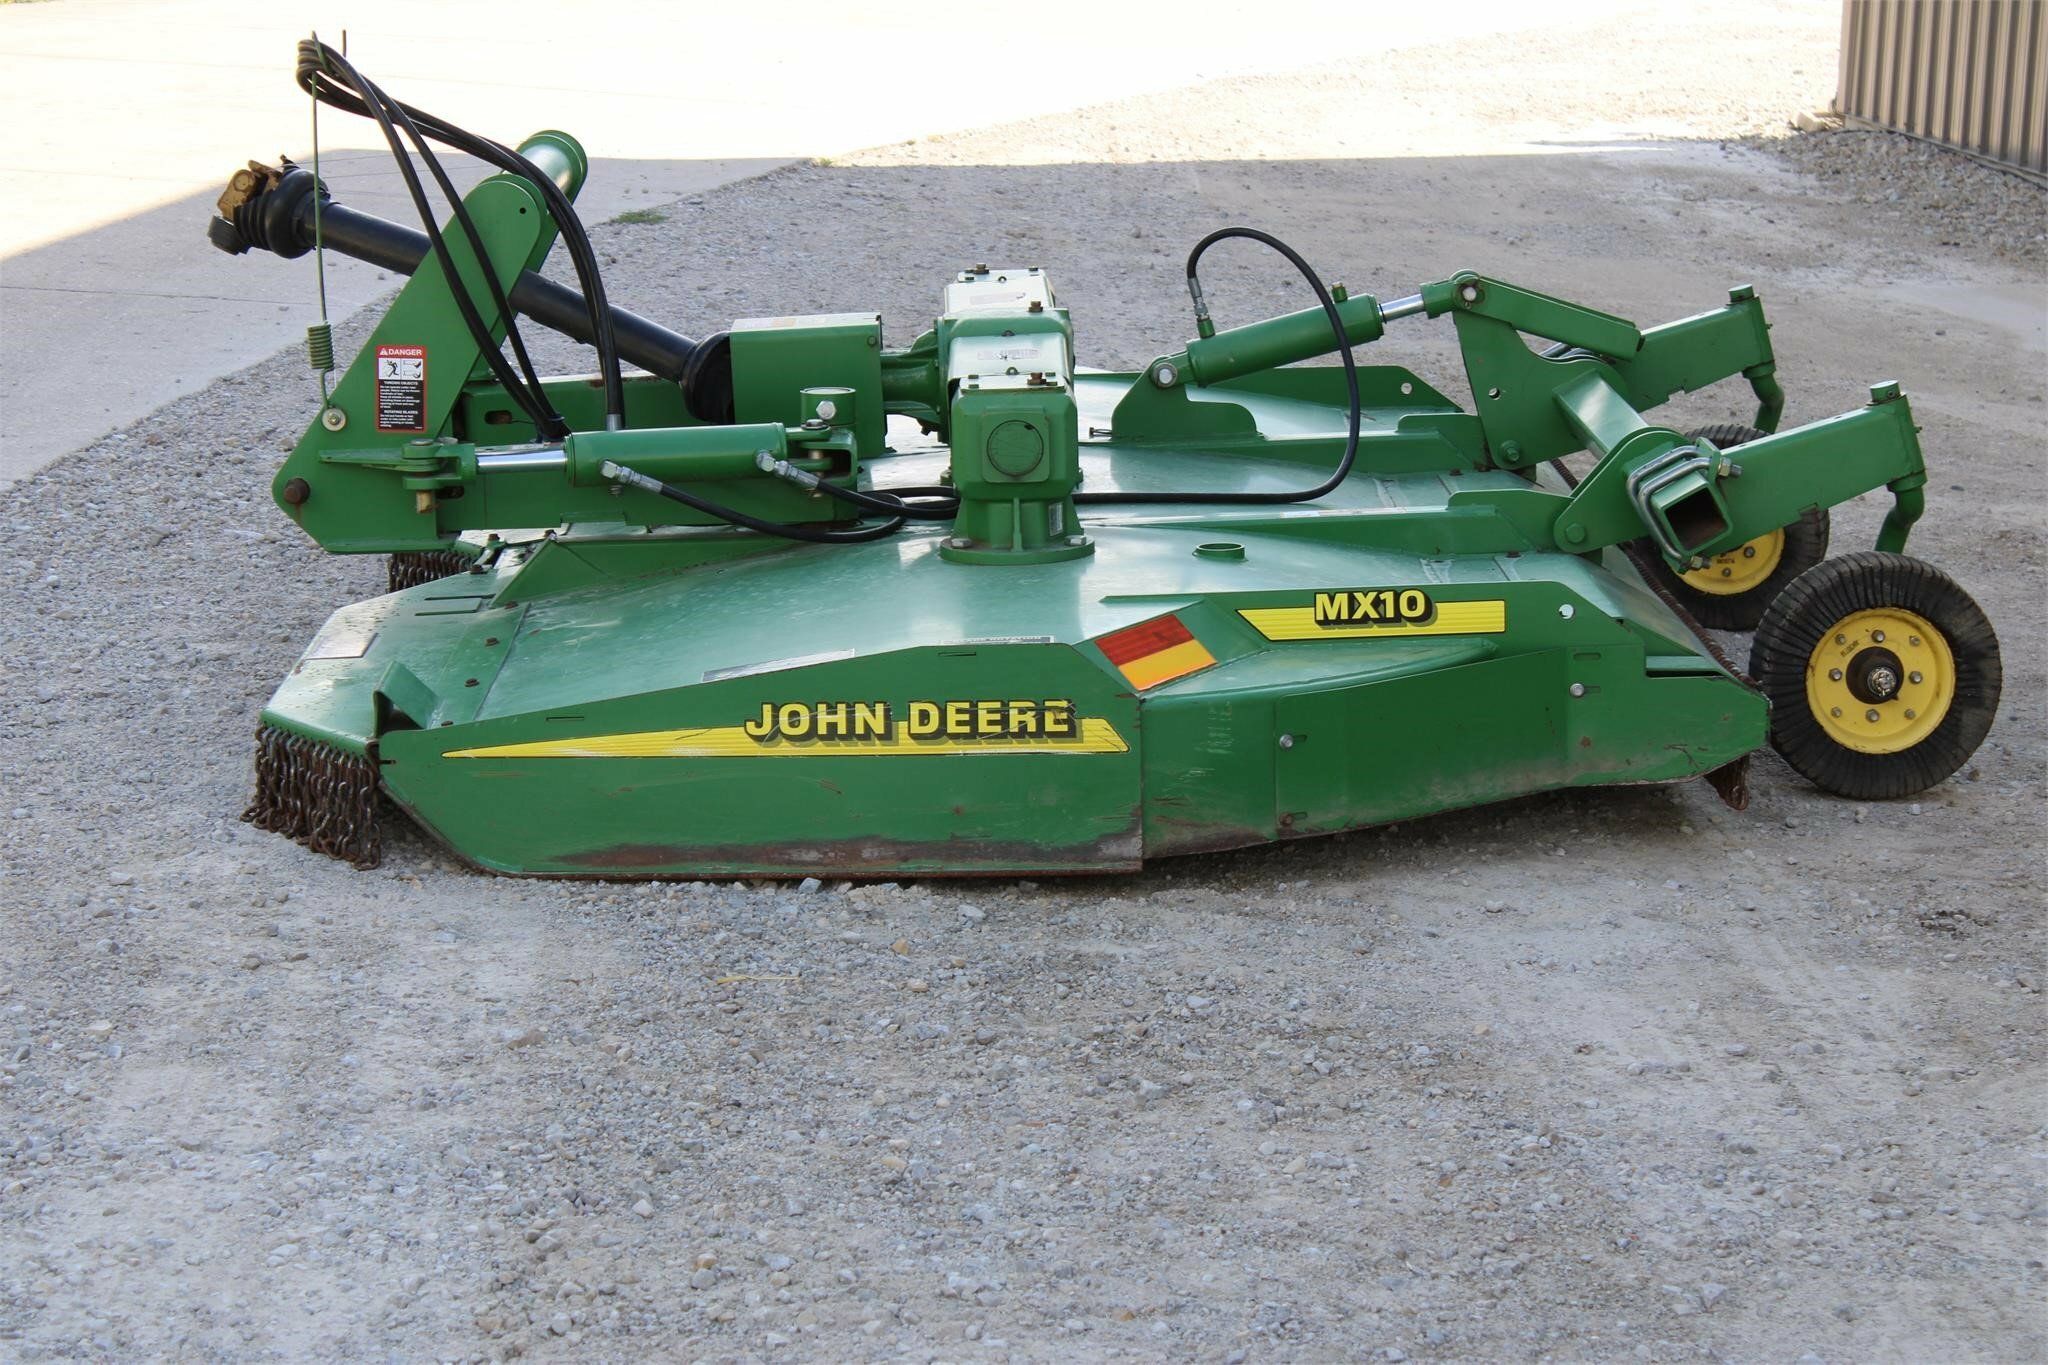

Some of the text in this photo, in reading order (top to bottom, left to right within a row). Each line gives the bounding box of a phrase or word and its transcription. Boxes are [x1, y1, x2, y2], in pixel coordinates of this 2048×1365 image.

[388, 348, 422, 356] DANGER
[1314, 588, 1431, 624] MX10
[743, 700, 1076, 741] JOHN DEERE
